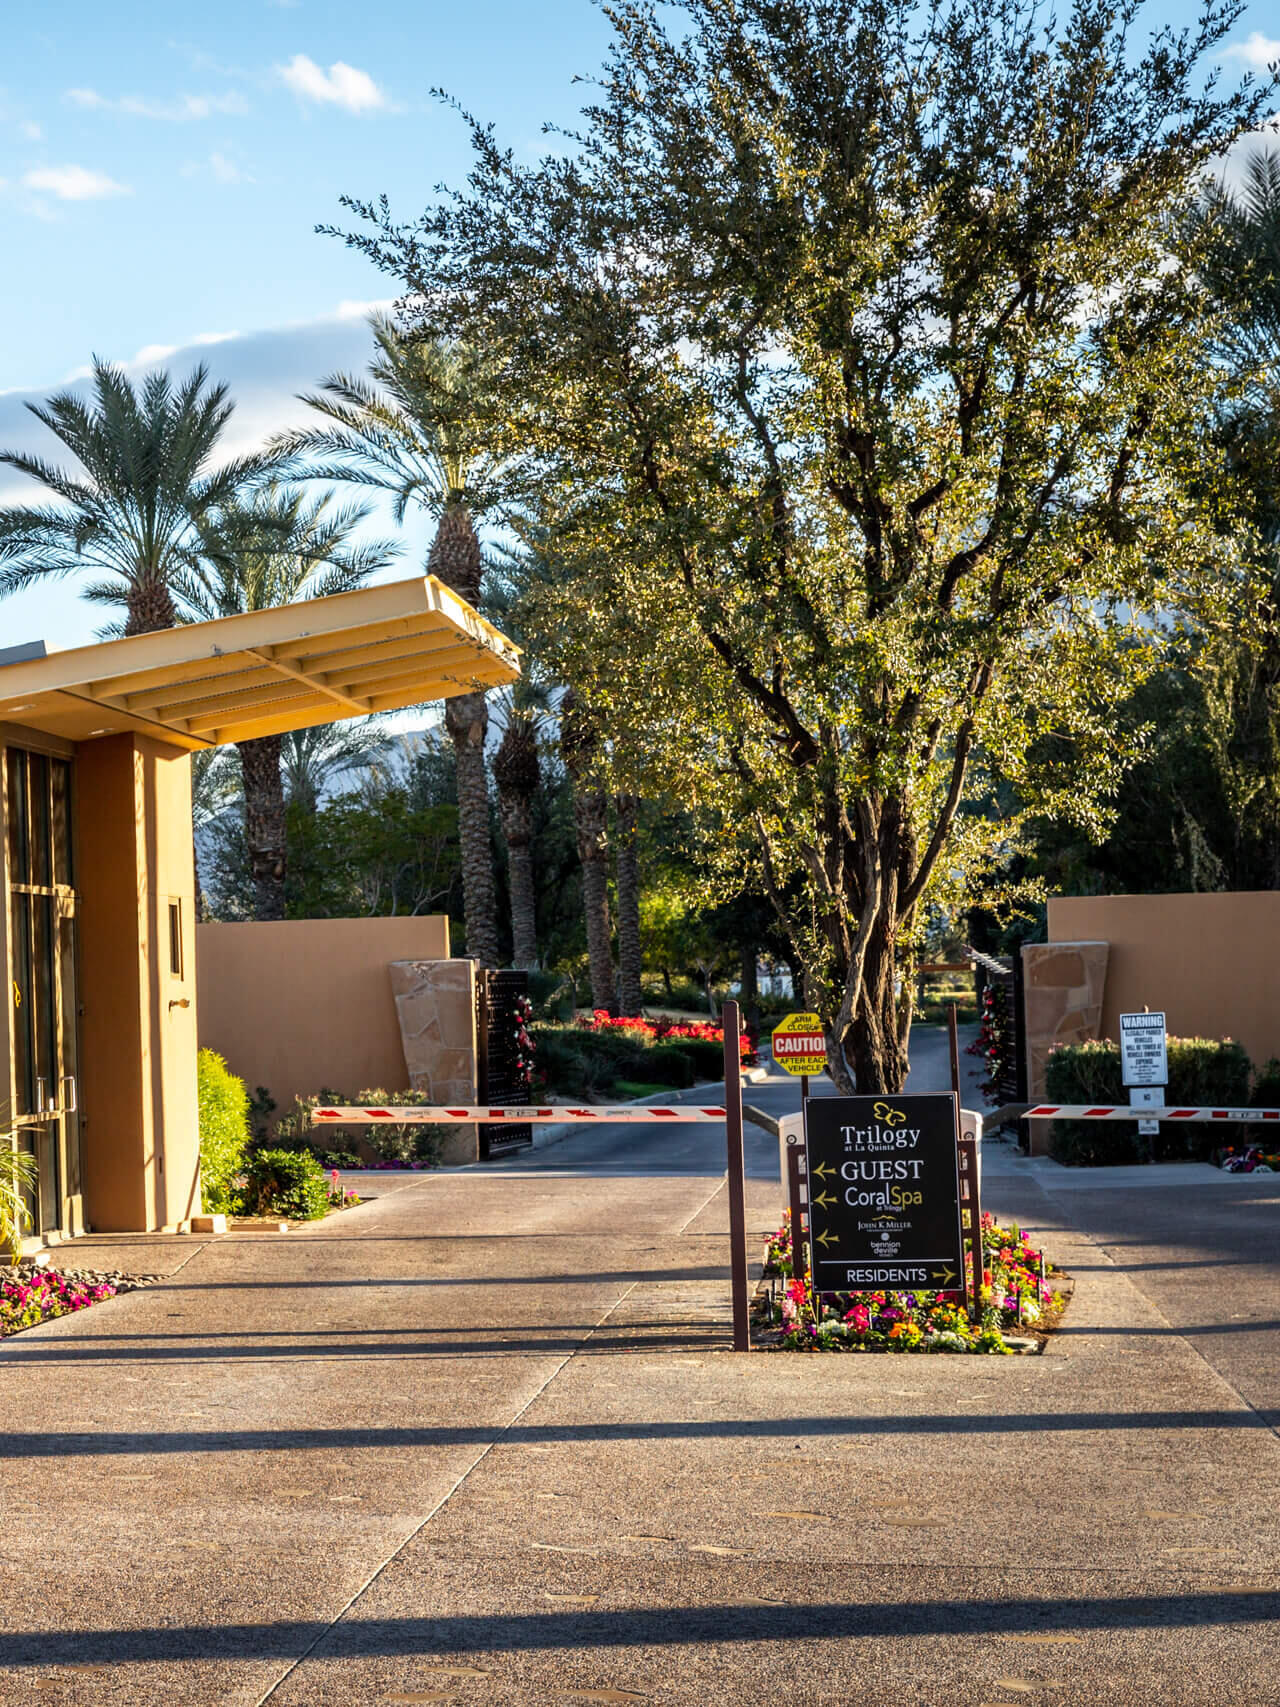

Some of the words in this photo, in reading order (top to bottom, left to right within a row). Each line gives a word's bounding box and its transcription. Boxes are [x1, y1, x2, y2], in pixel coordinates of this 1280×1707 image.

[1122, 1015, 1163, 1029] WARNING
[788, 1064, 821, 1072] VEHICLE
[840, 1125, 920, 1148] Trilogy
[867, 1143, 895, 1152] Quinta
[841, 1160, 924, 1180] GUEST
[847, 1268, 927, 1282] RESIDENTS
